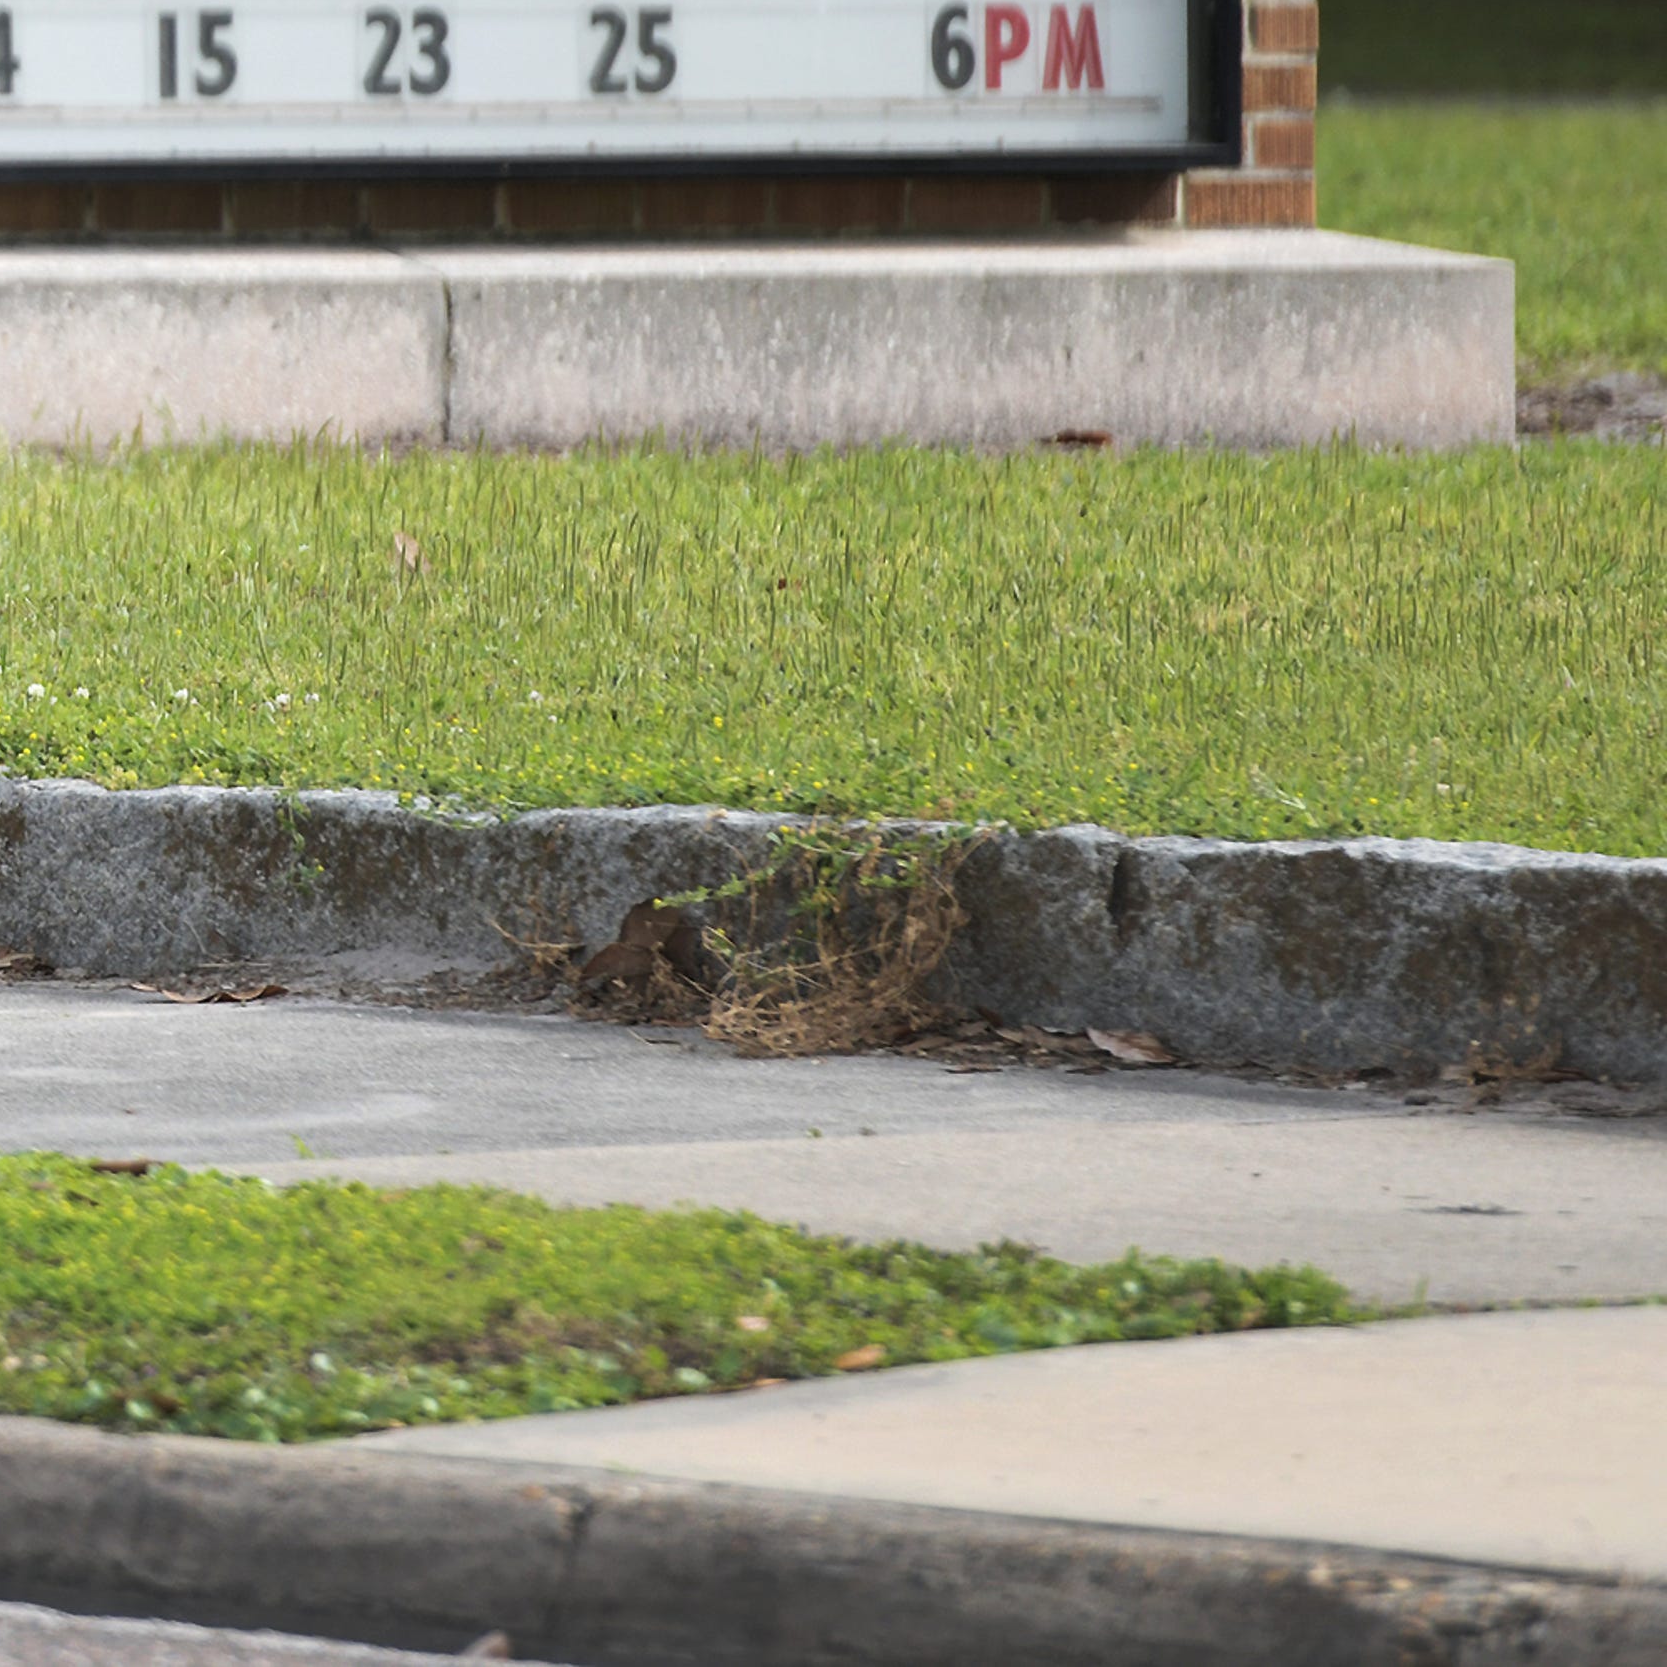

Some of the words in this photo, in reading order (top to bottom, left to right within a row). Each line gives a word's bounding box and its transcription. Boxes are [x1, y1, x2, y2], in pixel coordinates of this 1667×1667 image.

[156, 10, 239, 98] 15
[362, 9, 453, 98] 23
[588, 8, 679, 97] 25
[928, 2, 1107, 93] 6PM
